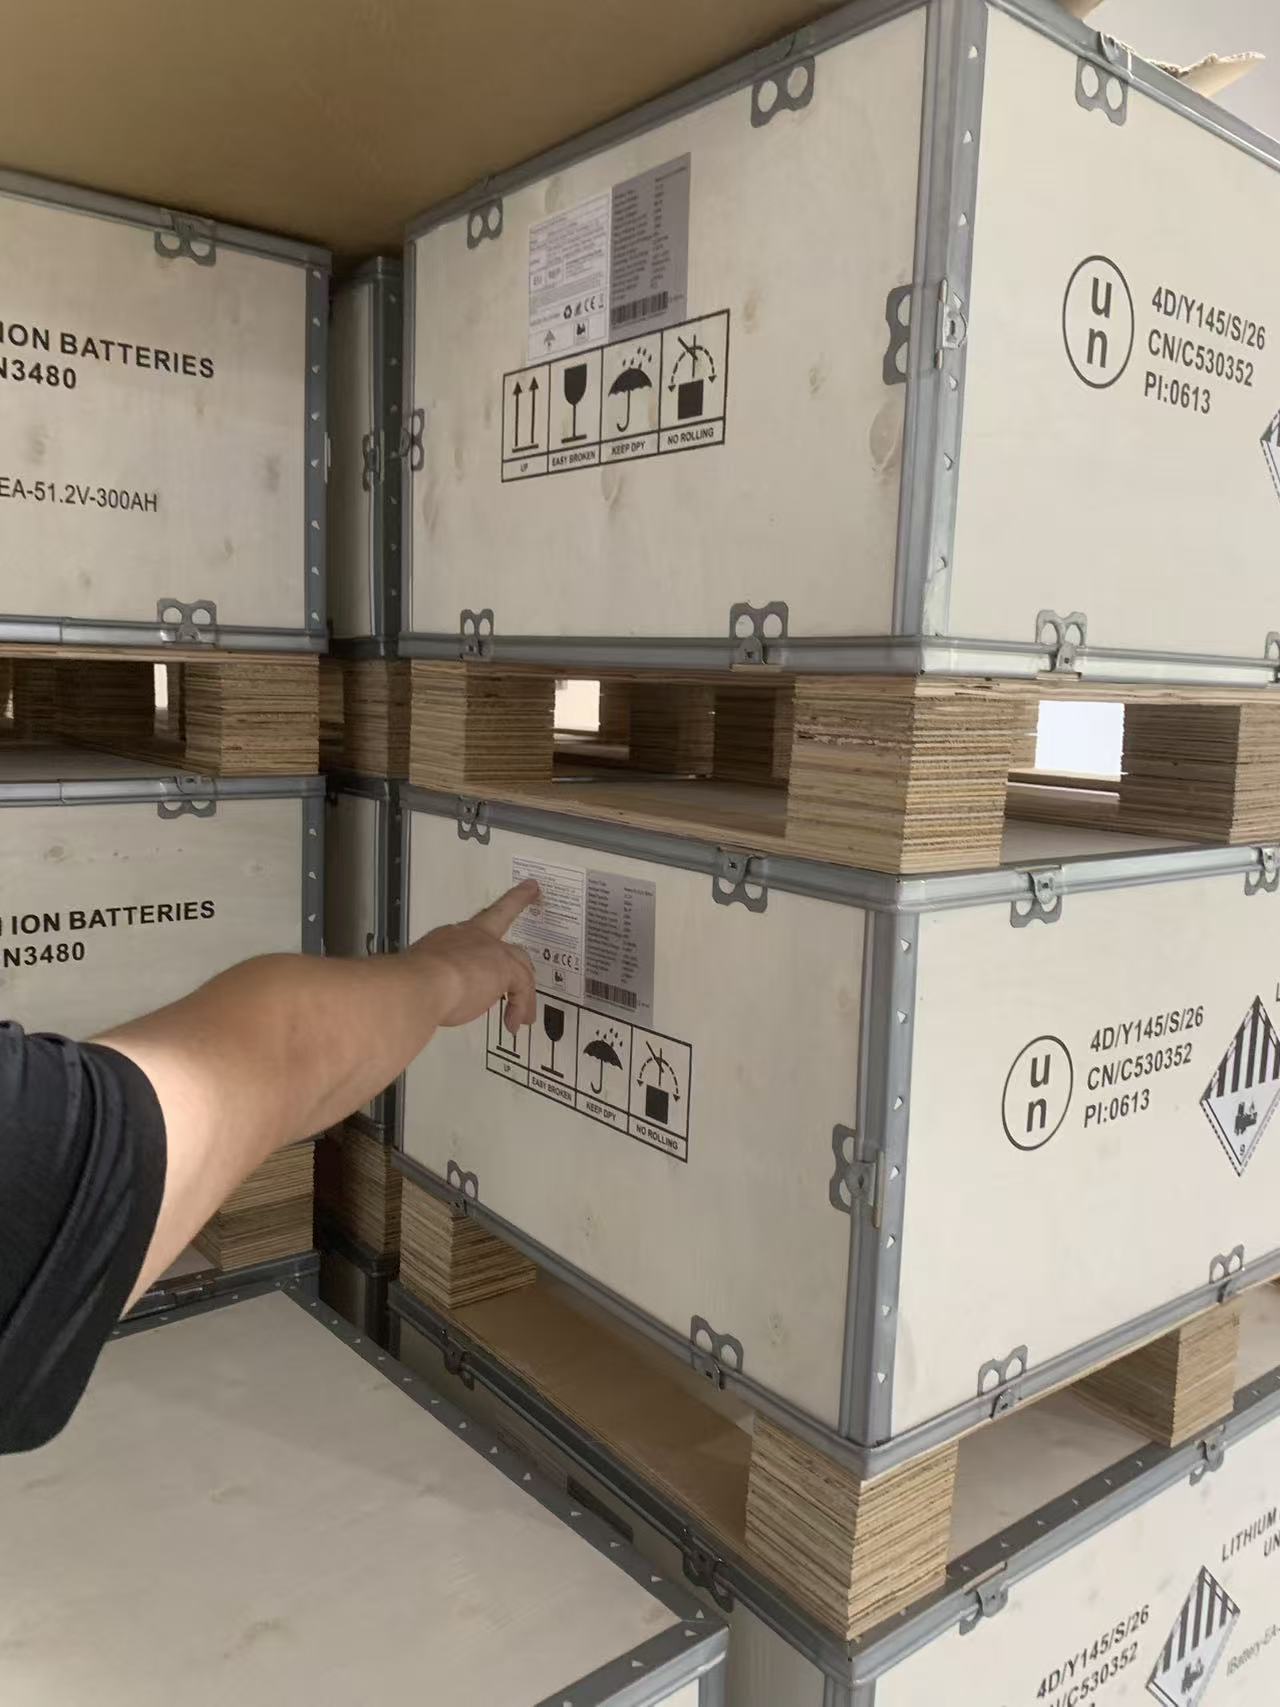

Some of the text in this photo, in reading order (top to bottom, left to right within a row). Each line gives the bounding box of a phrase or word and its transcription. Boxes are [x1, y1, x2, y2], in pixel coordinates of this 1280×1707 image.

[1091, 277, 1112, 319] u
[1151, 286, 1265, 350] 4D/Y145/S/26
[60, 332, 215, 379] BATTERIES
[1086, 327, 1108, 369] n
[1148, 329, 1254, 387] CN/C530352
[1144, 371, 1211, 414] PI:0613
[611, 443, 630, 456] KEEP
[667, 427, 714, 445] NO ROLLING
[551, 451, 596, 467] EASY BROKEN
[12, 912, 60, 935] ION
[69, 900, 215, 930] BATTERIES
[1090, 1005, 1204, 1052] 4D/Y145/S/26
[1030, 1054, 1051, 1088] u
[1087, 1043, 1192, 1091] CN/C530352
[531, 1076, 572, 1102] EASY BROKEN
[586, 1101, 602, 1115] KEEP
[1083, 1088, 1150, 1128] PI:0613
[1026, 1098, 1047, 1133] n
[636, 1124, 679, 1151] NO ROLLING
[1221, 1506, 1277, 1563] LITHIUM
[1036, 1604, 1150, 1699] 4D/Y145/S/26
